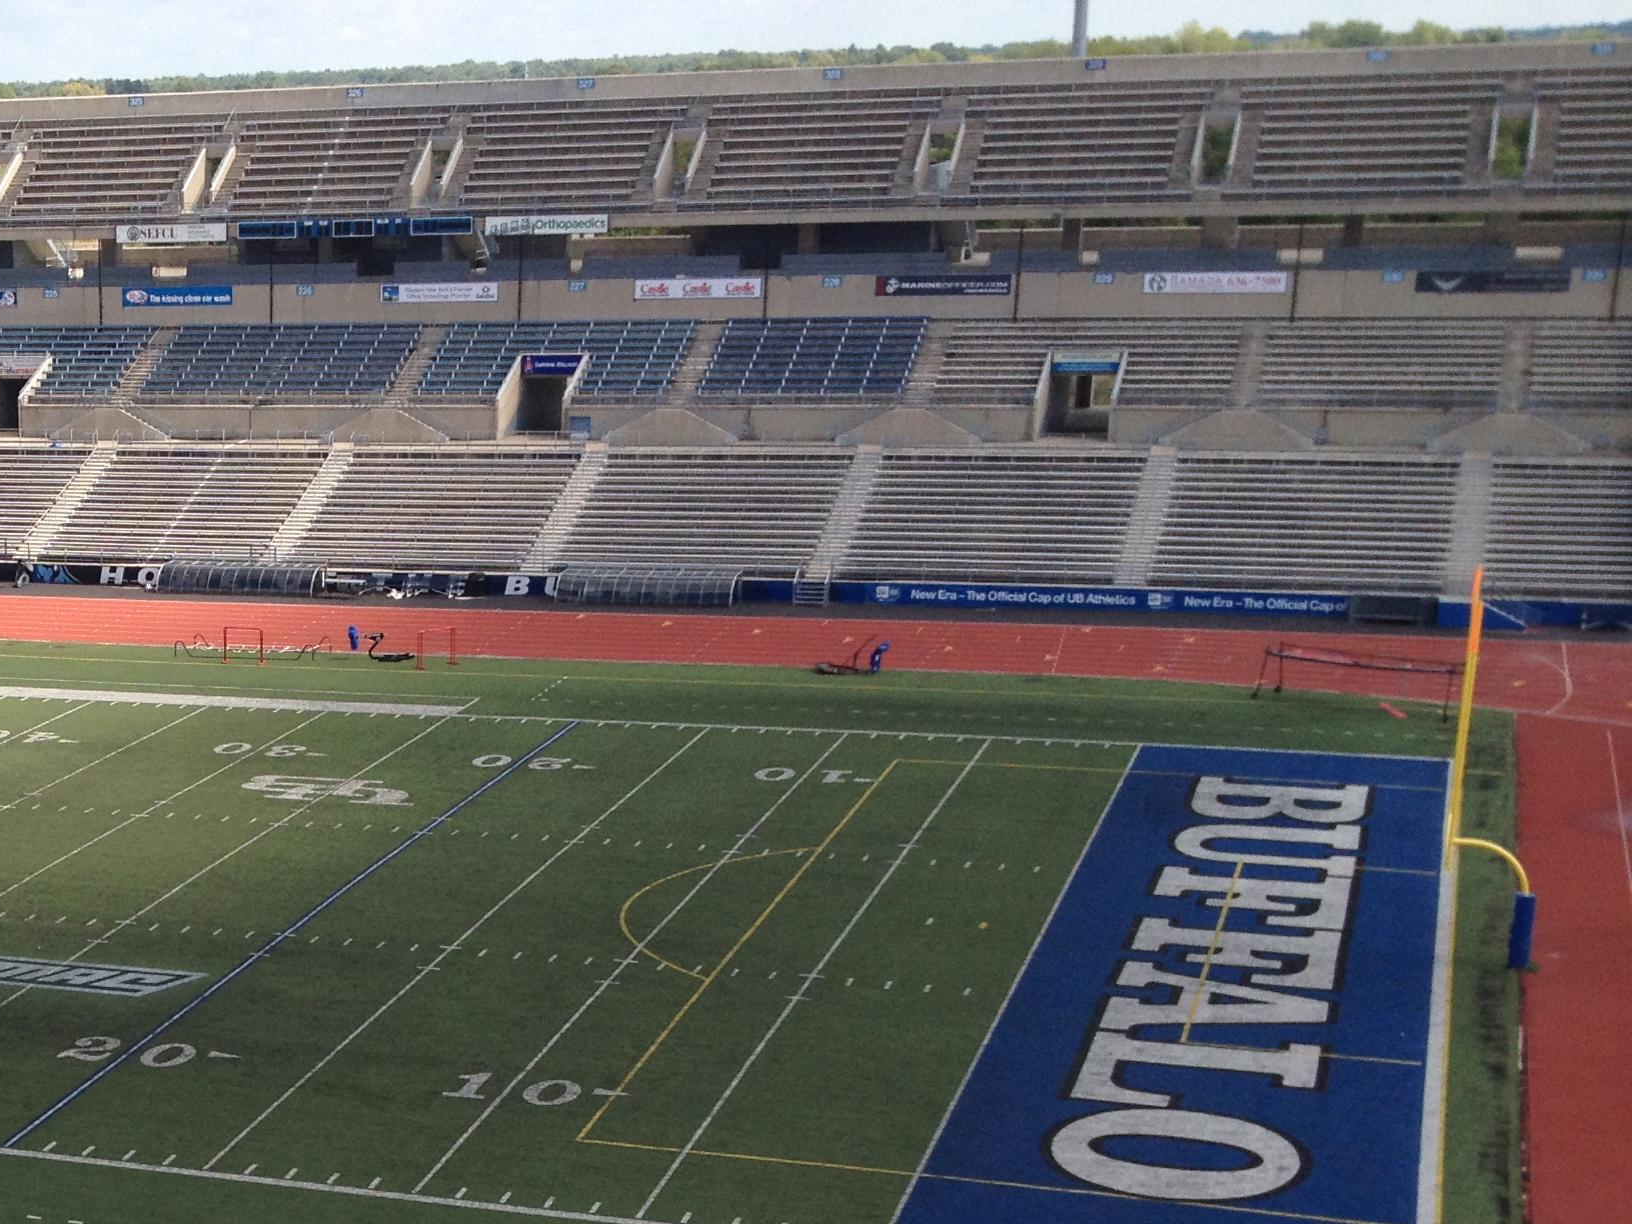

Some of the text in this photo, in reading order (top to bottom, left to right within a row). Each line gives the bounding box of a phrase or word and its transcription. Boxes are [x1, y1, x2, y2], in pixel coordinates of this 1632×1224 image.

[535, 218, 606, 231] Orthopaedics
[911, 590, 936, 600] New
[938, 590, 957, 600] Era
[966, 591, 985, 601] The
[988, 591, 1027, 602] Official
[1028, 593, 1052, 605] Cap
[1053, 594, 1066, 603] of
[1067, 594, 1084, 603] UB
[1087, 594, 1136, 605] Athletics
[1184, 596, 1210, 608] New
[1213, 597, 1233, 608] Era
[1244, 598, 1263, 609] The
[1266, 598, 1307, 610] Official
[1310, 599, 1333, 612] Cap
[213, 742, 307, 758] 30
[472, 754, 572, 771] 20
[754, 767, 855, 783] 10
[1048, 775, 1369, 1201] BUFFALO
[56, 1036, 197, 1068] 20
[441, 1072, 582, 1106] 10
